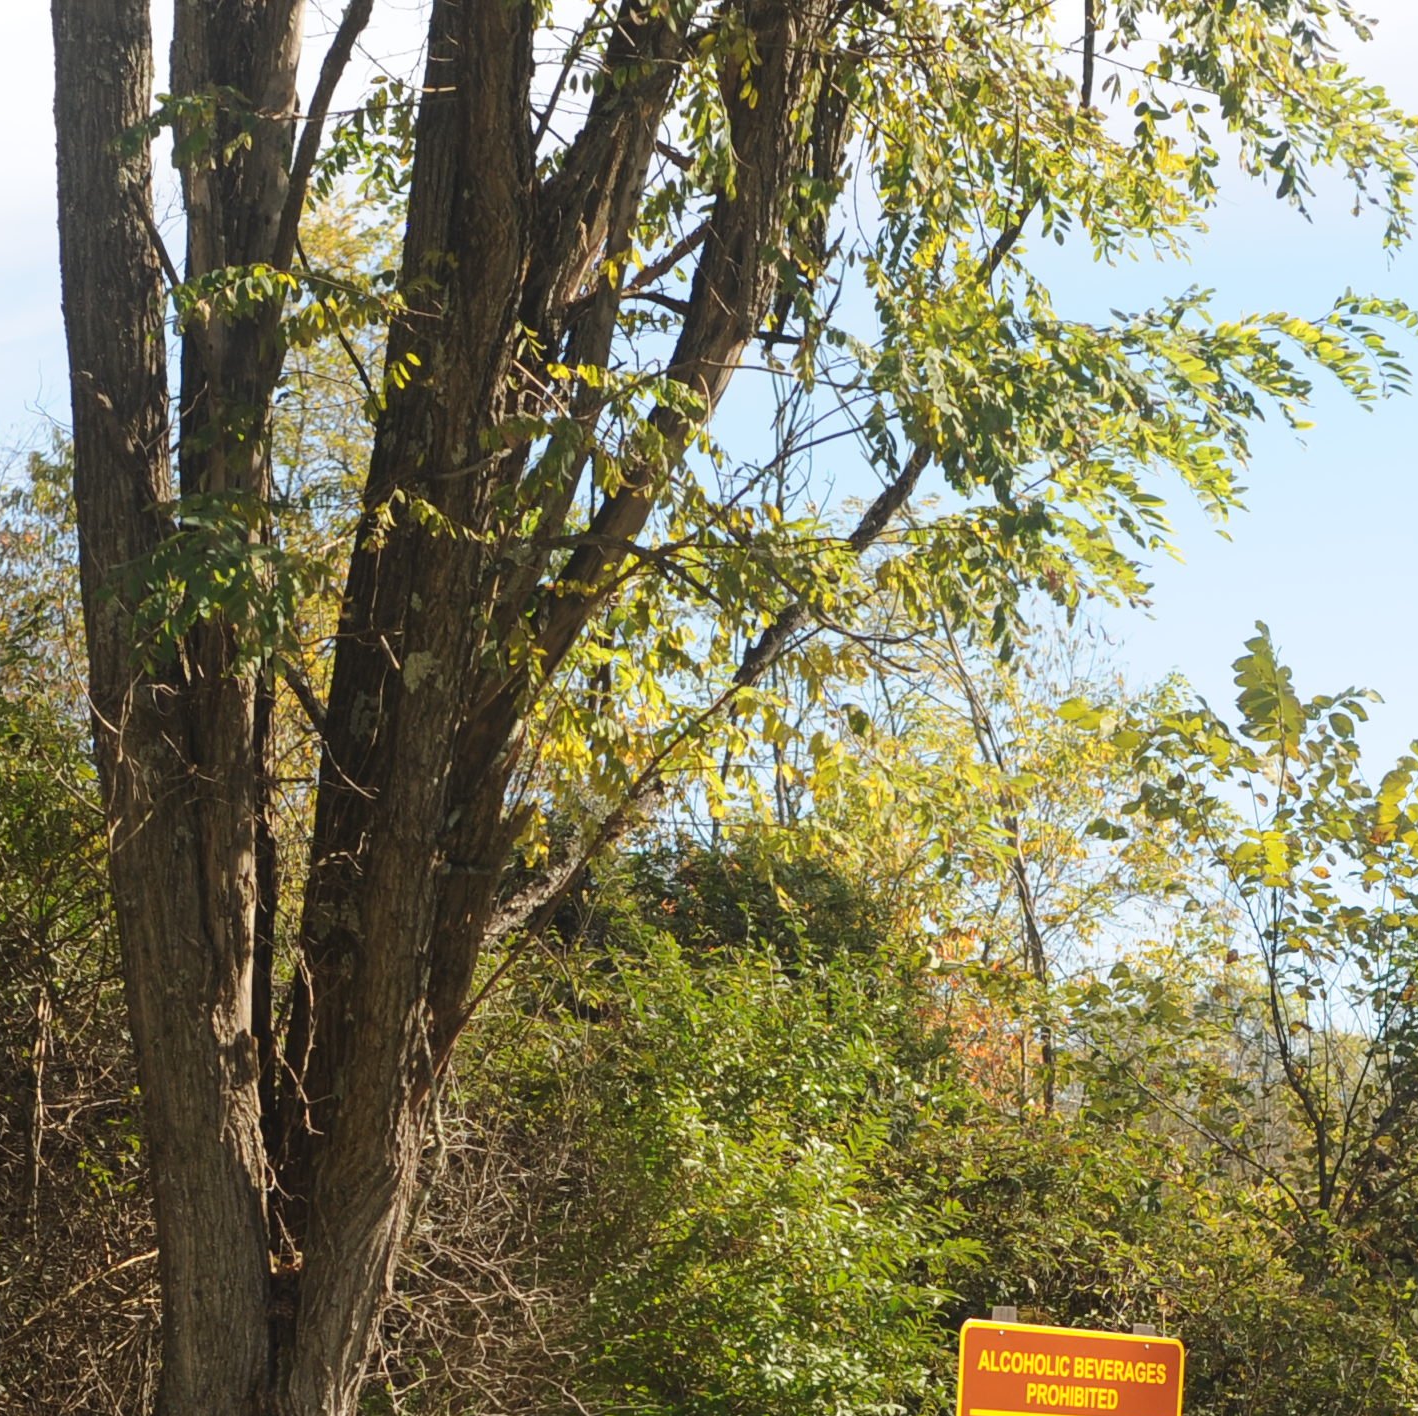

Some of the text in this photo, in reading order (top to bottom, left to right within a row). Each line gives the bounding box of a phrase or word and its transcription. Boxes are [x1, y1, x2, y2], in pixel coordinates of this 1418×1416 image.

[977, 1349, 1167, 1385] ALCOHOLIC BEVERAGES
[1026, 1383, 1119, 1410] PROHIBITED
